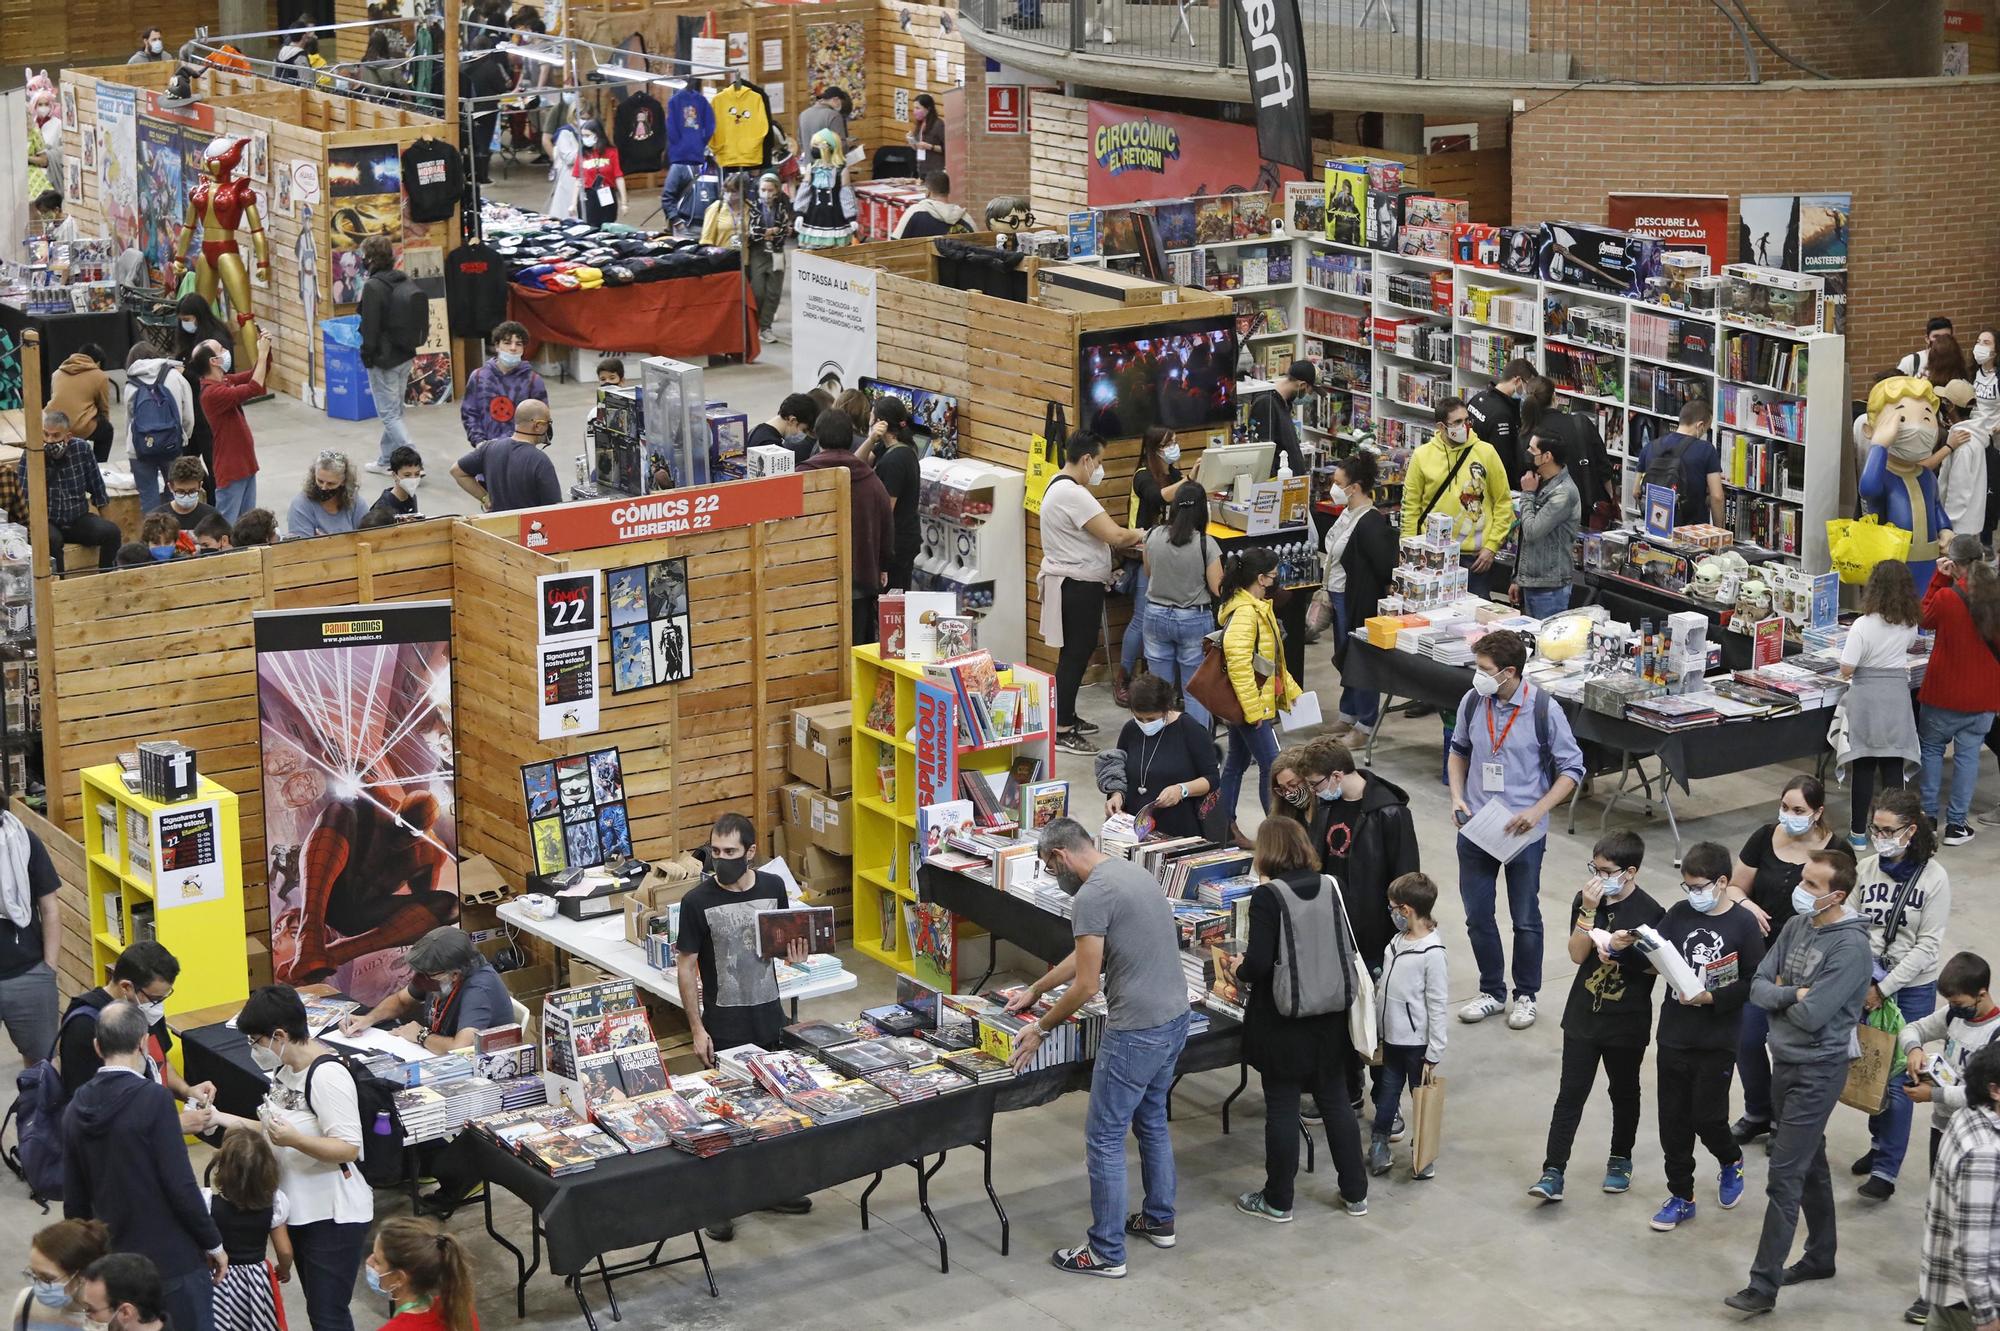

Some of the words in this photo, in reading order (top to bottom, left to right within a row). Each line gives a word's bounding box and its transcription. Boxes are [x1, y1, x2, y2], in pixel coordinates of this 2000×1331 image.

[1110, 152, 1121, 171] EL
[1122, 147, 1162, 169] RETORN
[1635, 217, 1686, 227] ¡DESCUBRE
[1687, 218, 1699, 227] LA
[1658, 228, 1706, 239] NOVEDAD!
[1805, 256, 1846, 266] COASTEERING
[798, 269, 810, 280] TOT
[812, 274, 832, 287] PASSA
[834, 279, 838, 288] A
[840, 281, 848, 291] LA
[611, 499, 689, 526] CÒMICS
[694, 494, 719, 513] 22
[619, 518, 689, 539] LLIBRERIA
[693, 514, 711, 529] 22
[552, 599, 586, 627] 22
[351, 621, 380, 632] COMICS
[323, 634, 382, 643] www.paninicomics.es
[545, 652, 577, 662] Signatures
[545, 658, 563, 667] nostre
[565, 655, 585, 665] estand
[548, 672, 559, 684] 22
[918, 692, 935, 806] SPIROU
[162, 823, 182, 831] nostre
[183, 818, 206, 827] estand
[163, 812, 197, 825] Signatures
[167, 836, 180, 848] 22
[353, 956, 384, 978] DAILY
[561, 991, 592, 1003] WARLOCK
[620, 1055, 632, 1064] LOS
[633, 1048, 657, 1061] NUEVOS
[621, 1056, 660, 1072] VENGADORES
